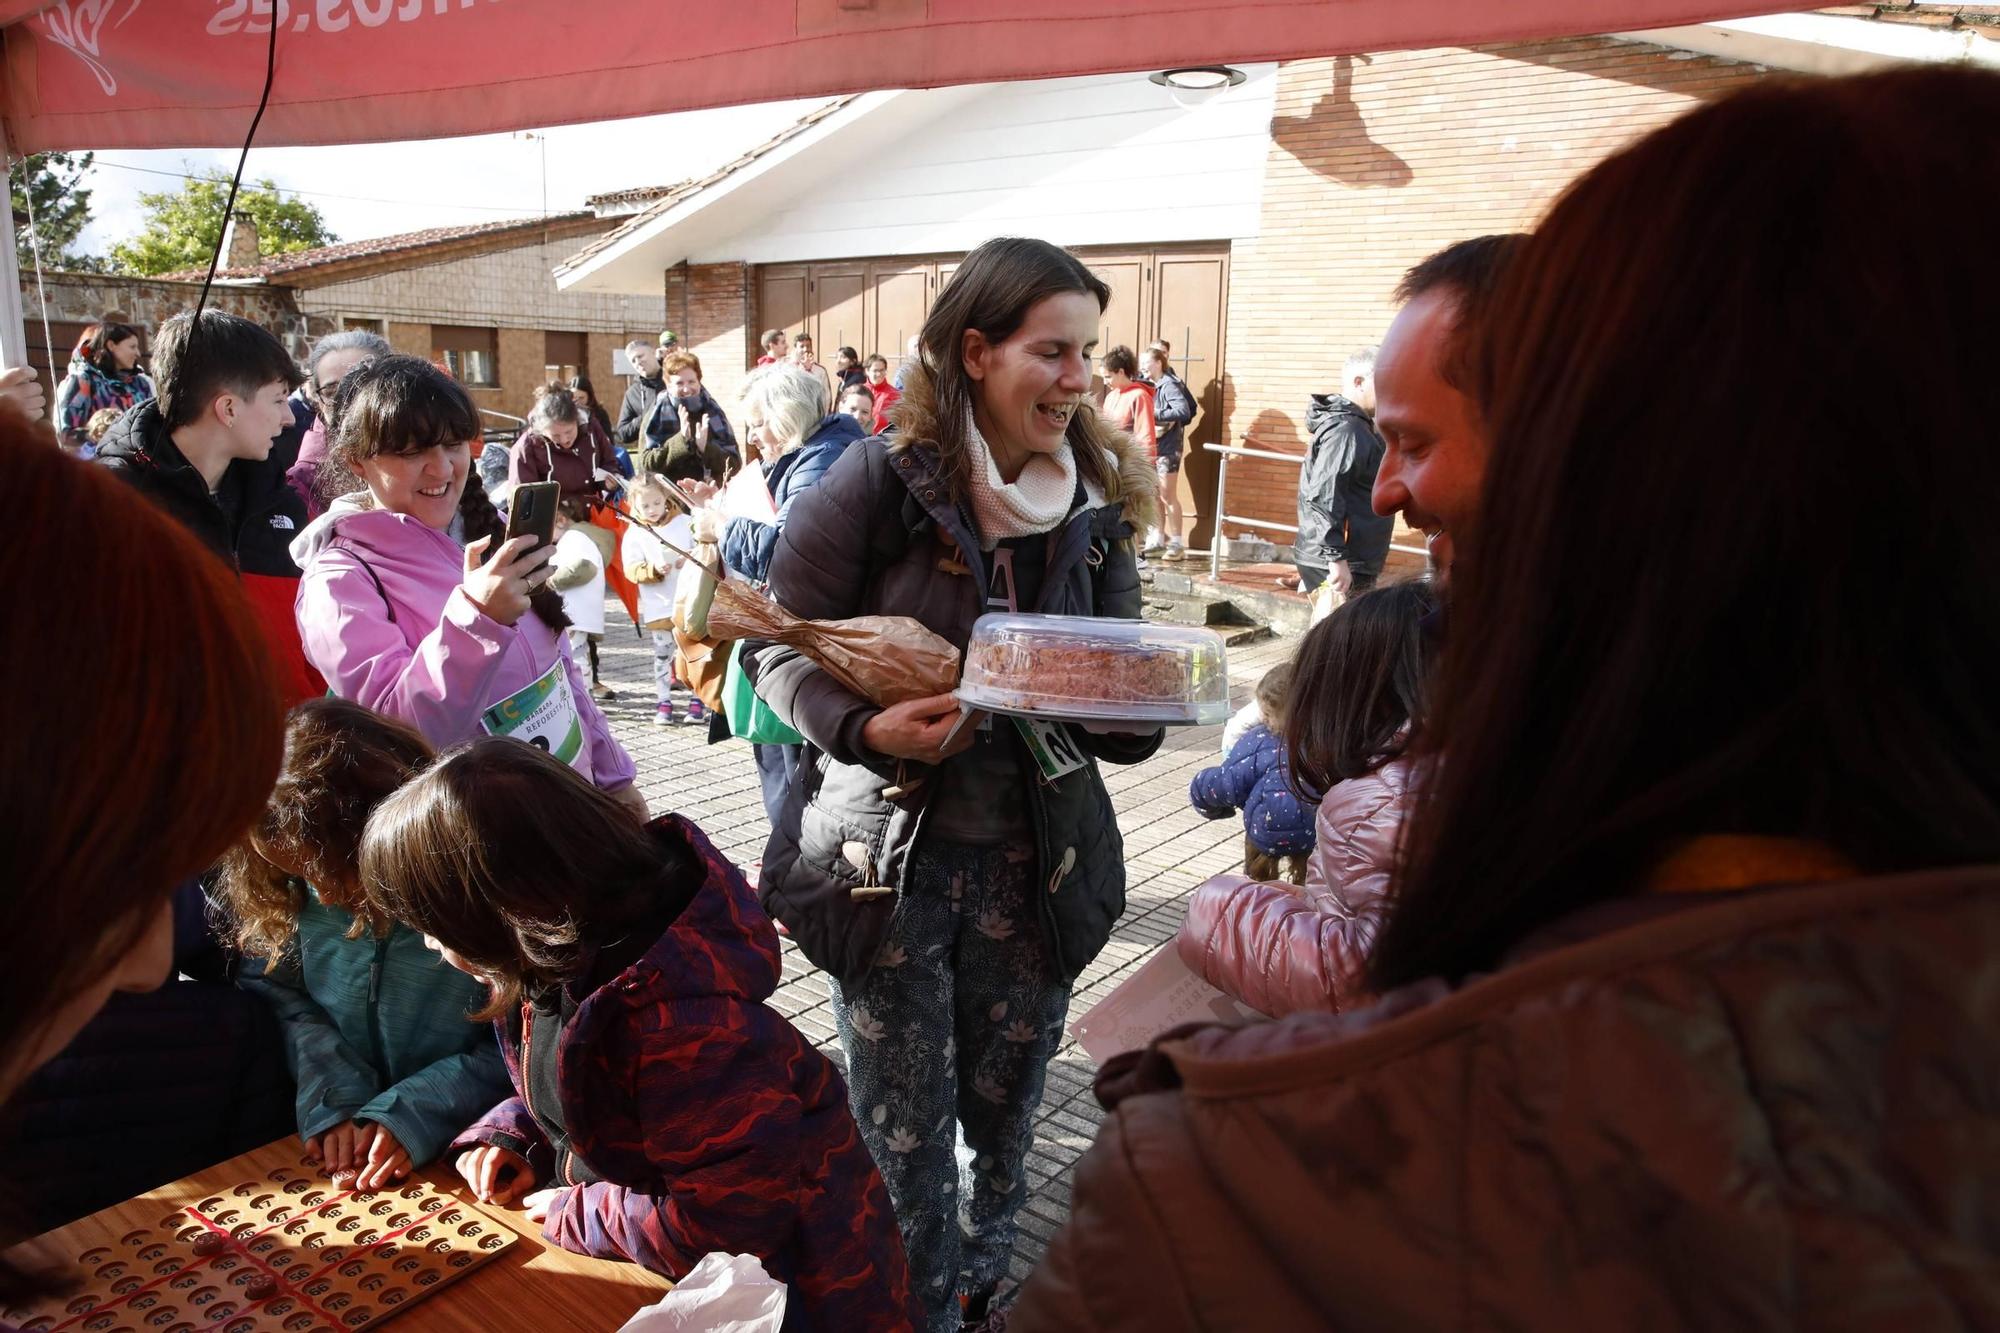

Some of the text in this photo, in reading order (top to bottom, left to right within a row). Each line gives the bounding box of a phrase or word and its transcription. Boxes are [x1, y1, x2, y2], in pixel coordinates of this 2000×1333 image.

[143, 1250, 163, 1260] 14
[219, 1216, 238, 1226] 16
[289, 1185, 307, 1194] 18
[159, 1264, 179, 1275] 24
[273, 1213, 288, 1223] 27
[308, 1197, 324, 1206] 28
[195, 1293, 215, 1305] 44
[273, 1256, 291, 1267] 46
[309, 1238, 324, 1249] 47
[343, 1222, 360, 1232] 48
[376, 1205, 392, 1216] 49
[212, 1202, 443, 1320] 54 56 57 58 59 60
[271, 1303, 292, 1316] 65
[309, 1283, 330, 1295] 66
[345, 1265, 362, 1277] 67
[380, 1248, 399, 1259] 68
[414, 1231, 431, 1241] 69
[447, 1214, 462, 1224] 70
[134, 1298, 156, 1310] 33
[175, 1279, 197, 1288] 34
[215, 1260, 236, 1270] 35
[252, 1242, 273, 1252] 36
[329, 1298, 350, 1310] 76
[366, 1280, 383, 1291] 77
[400, 1261, 419, 1272] 78
[434, 1243, 451, 1253] 79
[465, 1226, 483, 1237] 80
[349, 1239, 504, 1325] 86 87 88 89 90
